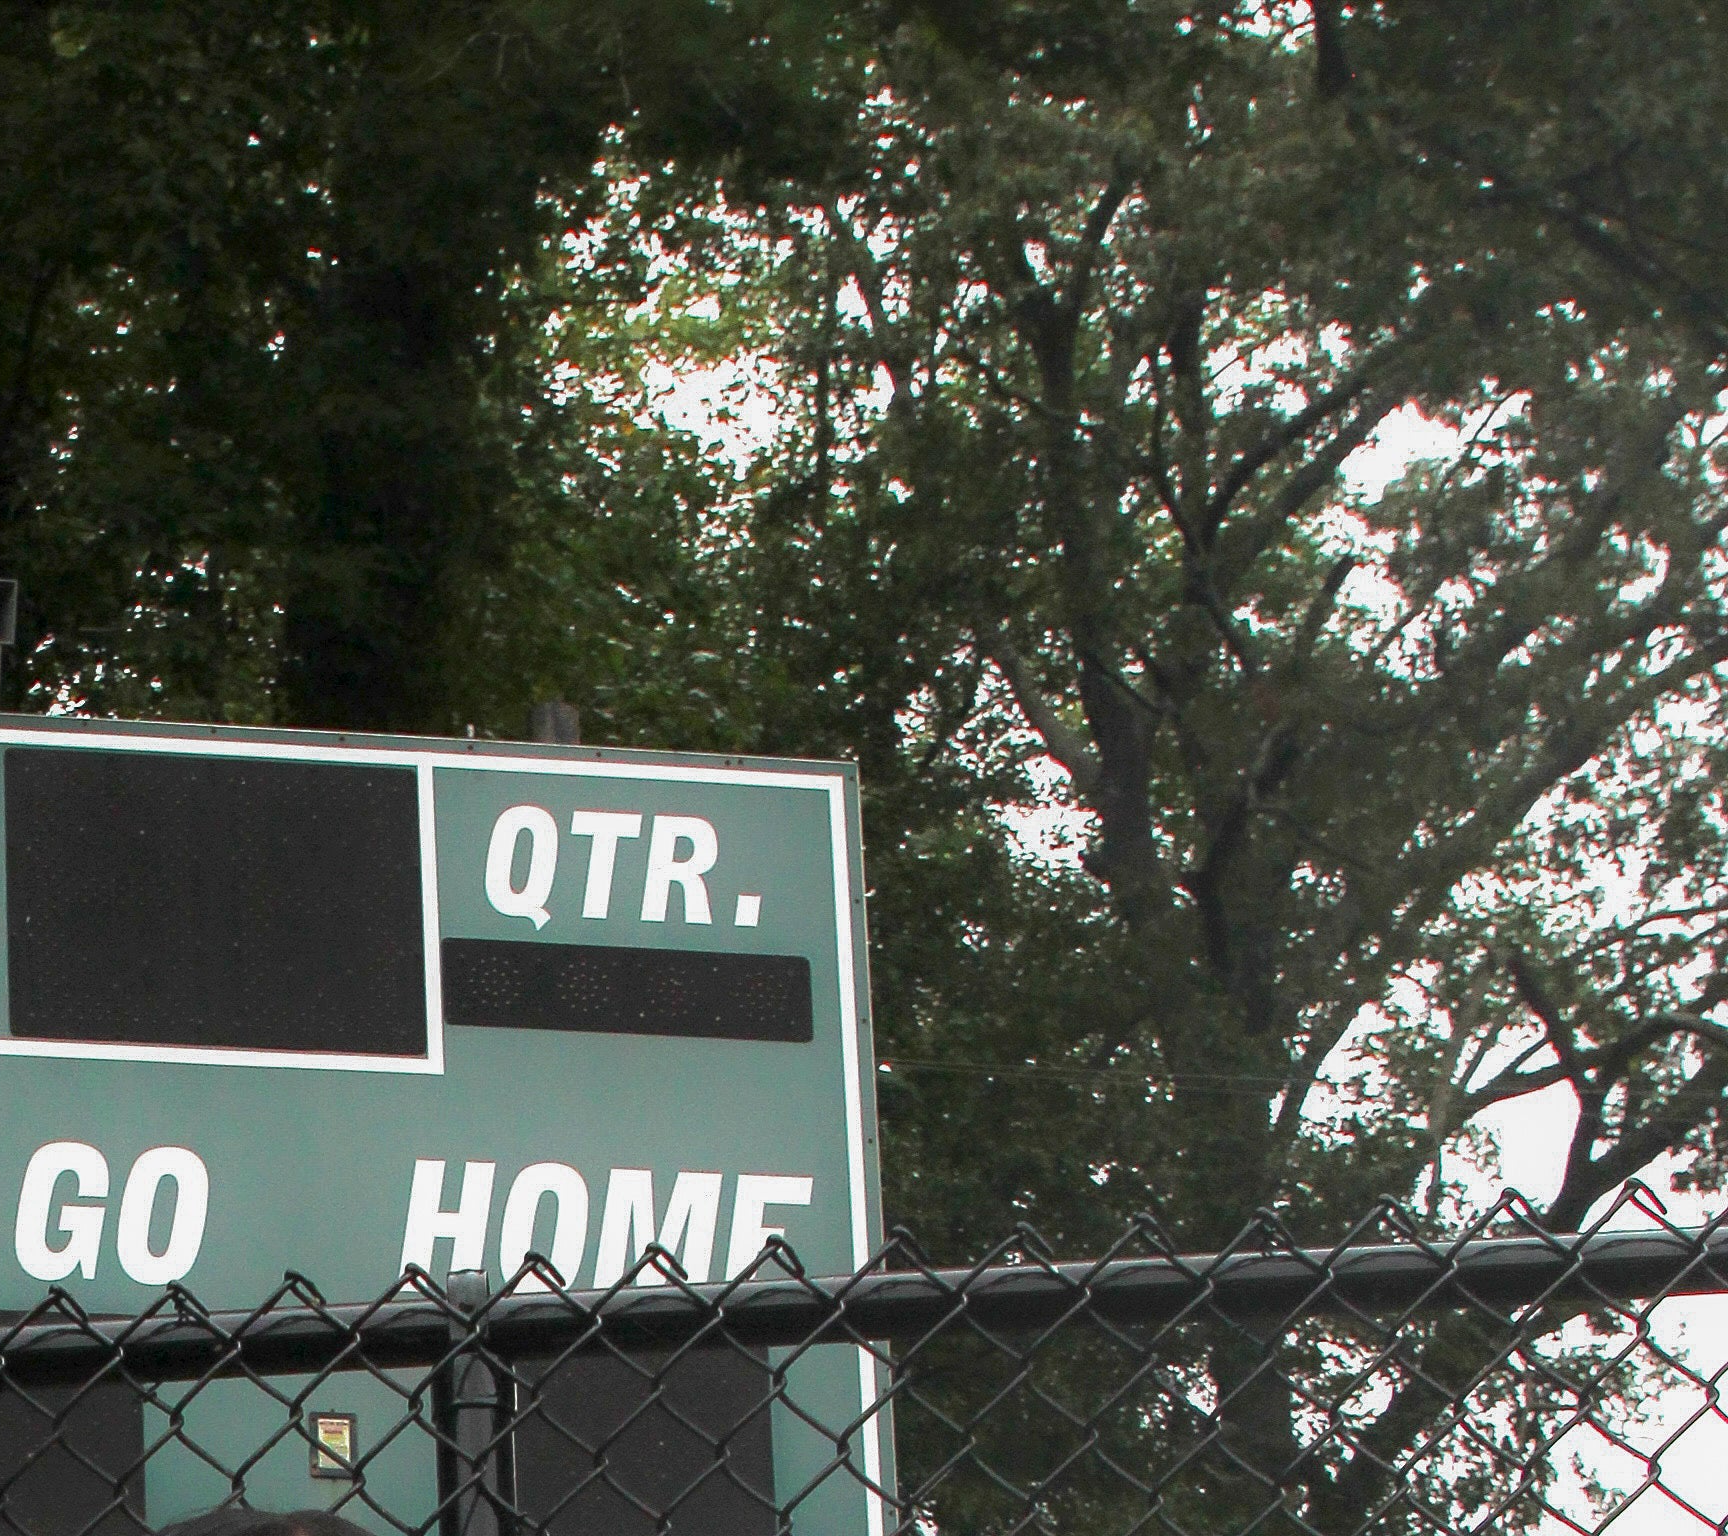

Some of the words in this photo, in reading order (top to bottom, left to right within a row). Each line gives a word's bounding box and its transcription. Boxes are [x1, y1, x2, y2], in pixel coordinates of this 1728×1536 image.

[485, 805, 763, 931] QTR.
[15, 1140, 209, 1285] GO
[398, 1158, 815, 1296] HOME
